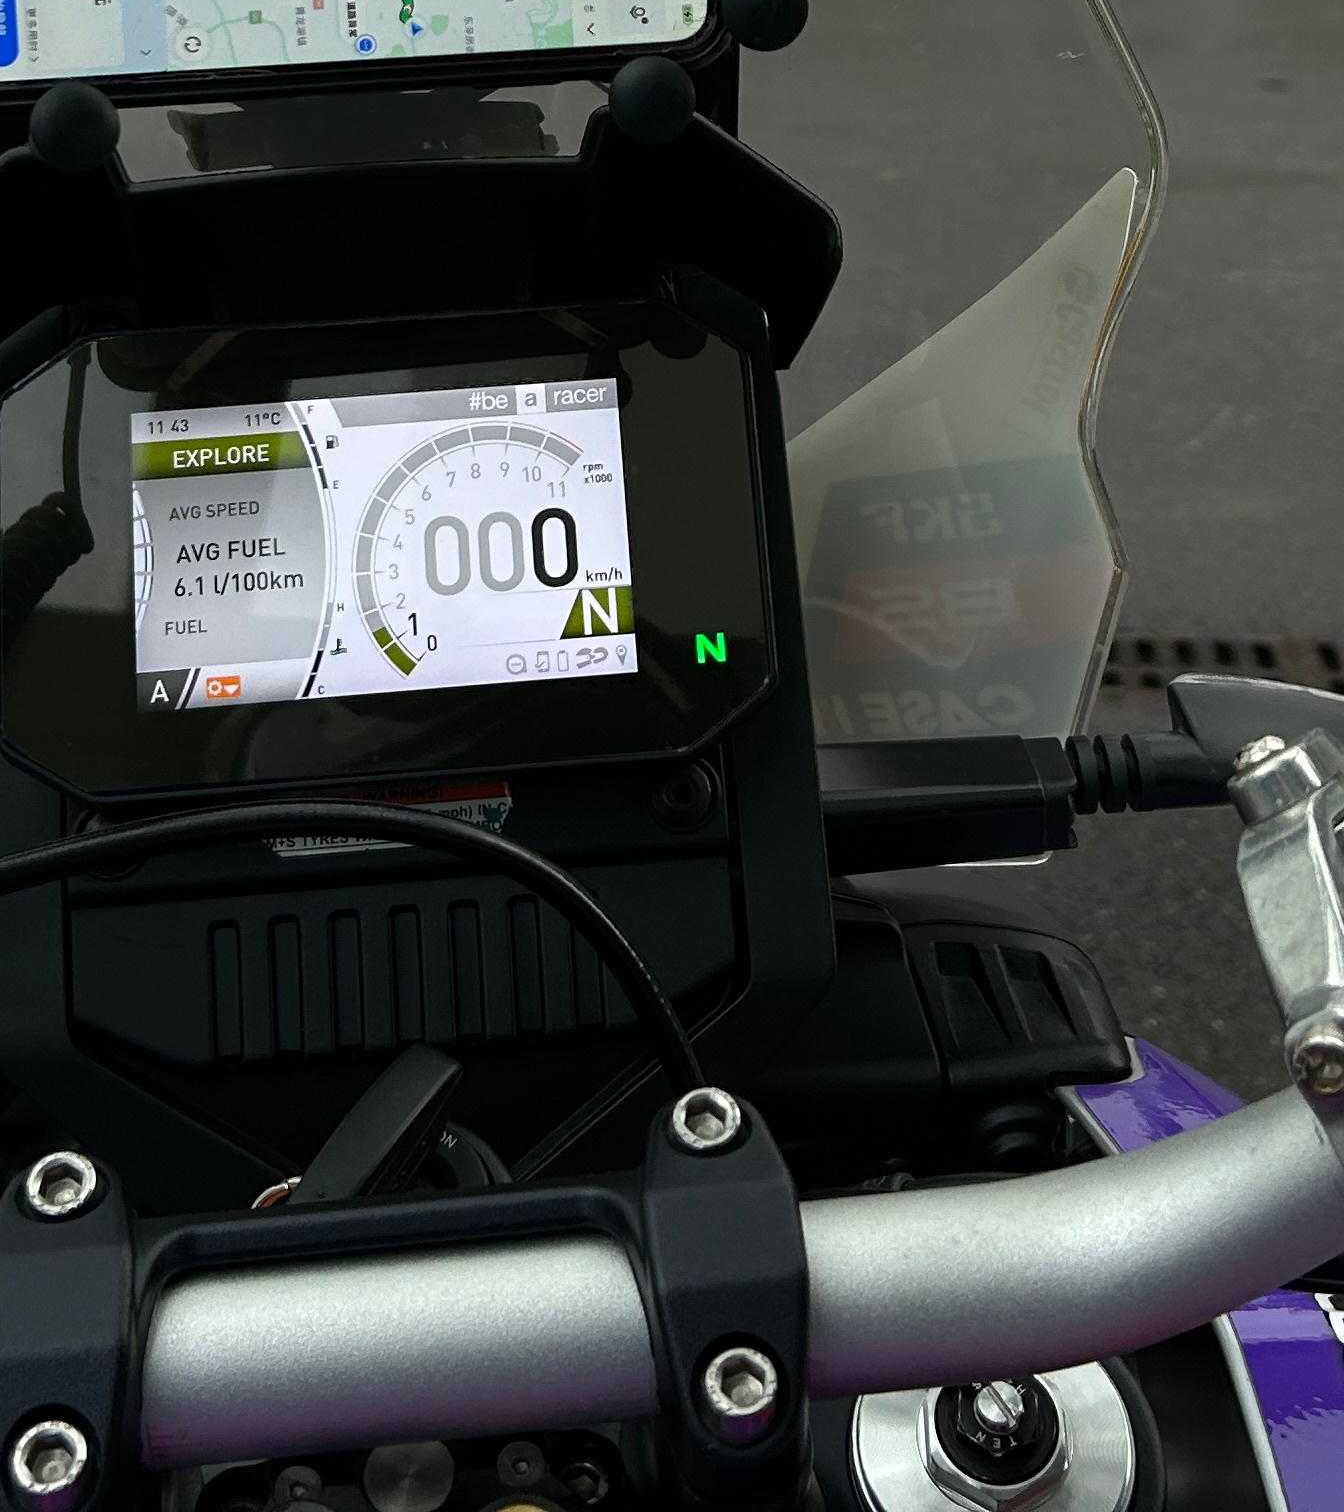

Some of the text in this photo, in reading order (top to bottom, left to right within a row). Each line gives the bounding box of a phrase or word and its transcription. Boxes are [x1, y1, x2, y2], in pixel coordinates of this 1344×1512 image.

[469, 386, 607, 411] #be a racer
[148, 419, 189, 434] 11 43
[173, 444, 270, 469] EXPLORE
[471, 463, 481, 479] 8
[500, 462, 510, 477] 9
[523, 467, 542, 483] 10
[583, 463, 603, 473] rpm
[333, 480, 339, 489] E
[446, 472, 456, 487] 7
[584, 473, 613, 484] x1000
[421, 485, 431, 501] 6
[548, 481, 566, 498] 11
[169, 500, 260, 521] AVG SPEED
[405, 509, 415, 525] 5
[393, 533, 404, 550] 4
[176, 538, 286, 564] AVG FUEL
[424, 507, 622, 596] 000 km/h
[388, 564, 399, 580] 3
[174, 572, 304, 597] 6.1 l/100km
[337, 603, 344, 612] H
[396, 593, 406, 609] 2
[581, 588, 619, 635] N
[165, 619, 207, 636] FUEL
[408, 613, 418, 636] 1
[427, 635, 437, 651] 0
[696, 632, 726, 664] N
[150, 680, 169, 704] A
[318, 685, 325, 695] C
[364, 787, 444, 802] WARNING!
